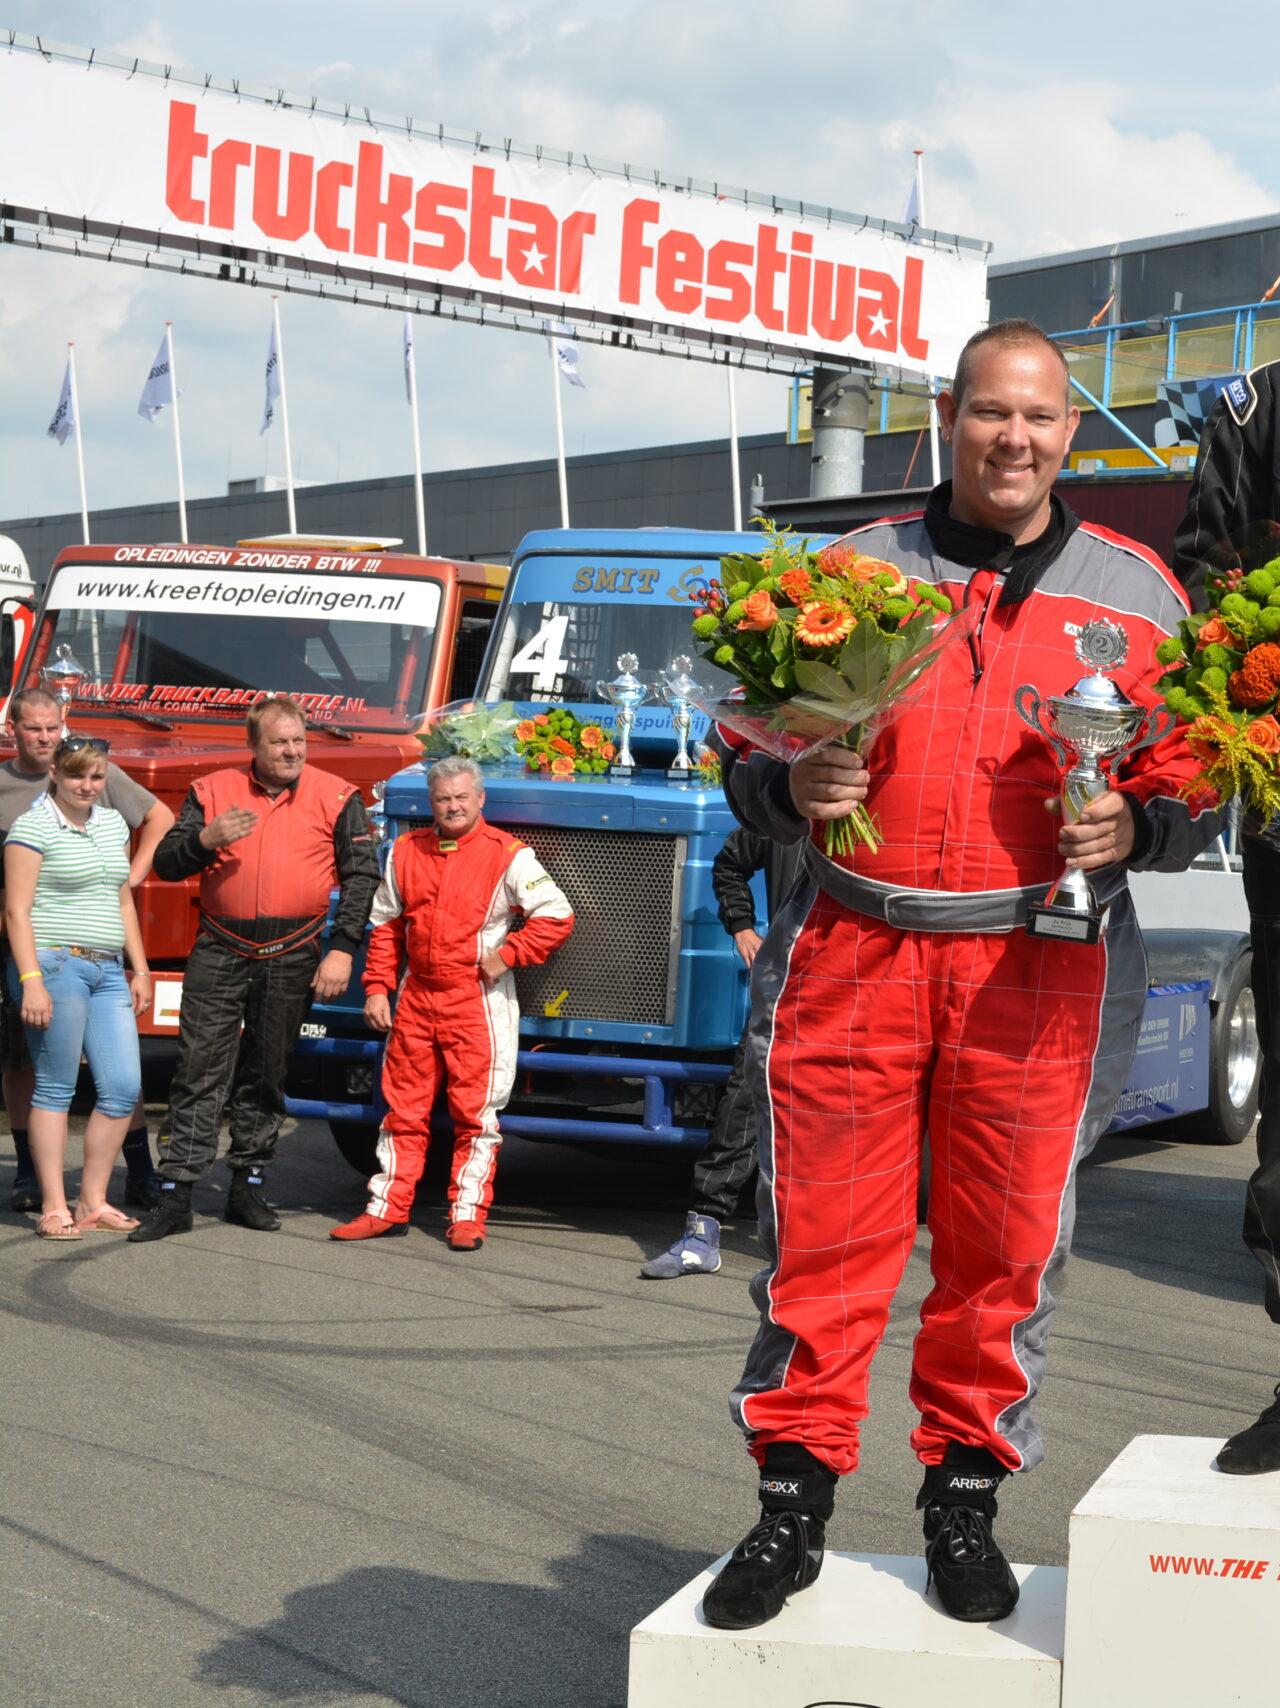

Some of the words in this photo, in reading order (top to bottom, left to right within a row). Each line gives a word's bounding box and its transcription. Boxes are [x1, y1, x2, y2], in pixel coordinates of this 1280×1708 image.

[166, 100, 596, 294] truckstar
[619, 198, 930, 362] festival
[113, 547, 232, 566] OPLEIDINGEN
[234, 551, 312, 570] ZONDER
[314, 556, 361, 572] BTW
[572, 567, 661, 594] SMIT
[76, 579, 405, 613] www.kreeftopleidingen.nl
[509, 615, 570, 689] 4
[1095, 636, 1108, 654] 2
